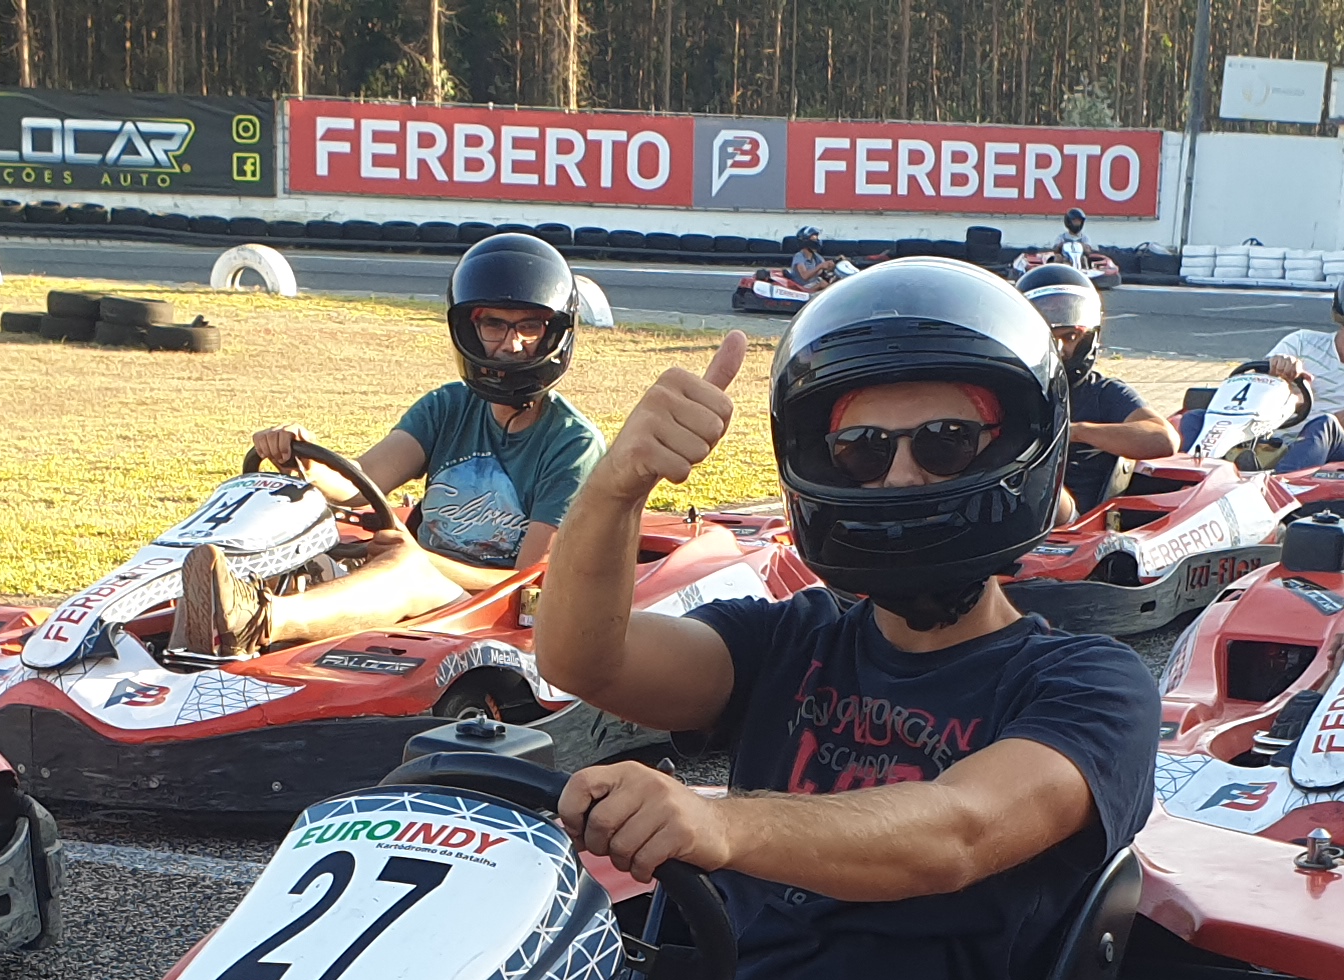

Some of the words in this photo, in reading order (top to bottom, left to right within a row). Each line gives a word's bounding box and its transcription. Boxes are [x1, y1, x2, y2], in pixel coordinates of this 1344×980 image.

[315, 116, 672, 190] FERBERTO
[814, 137, 1140, 201] FERBERTO
[101, 172, 171, 188] AUTO
[1231, 382, 1252, 405] 4
[179, 488, 263, 531] 14
[43, 557, 174, 643] FERBERTO
[293, 820, 509, 854] EUROINDY
[376, 842, 438, 854] Kartódromo
[440, 849, 453, 857] da
[455, 851, 497, 868] Batalha
